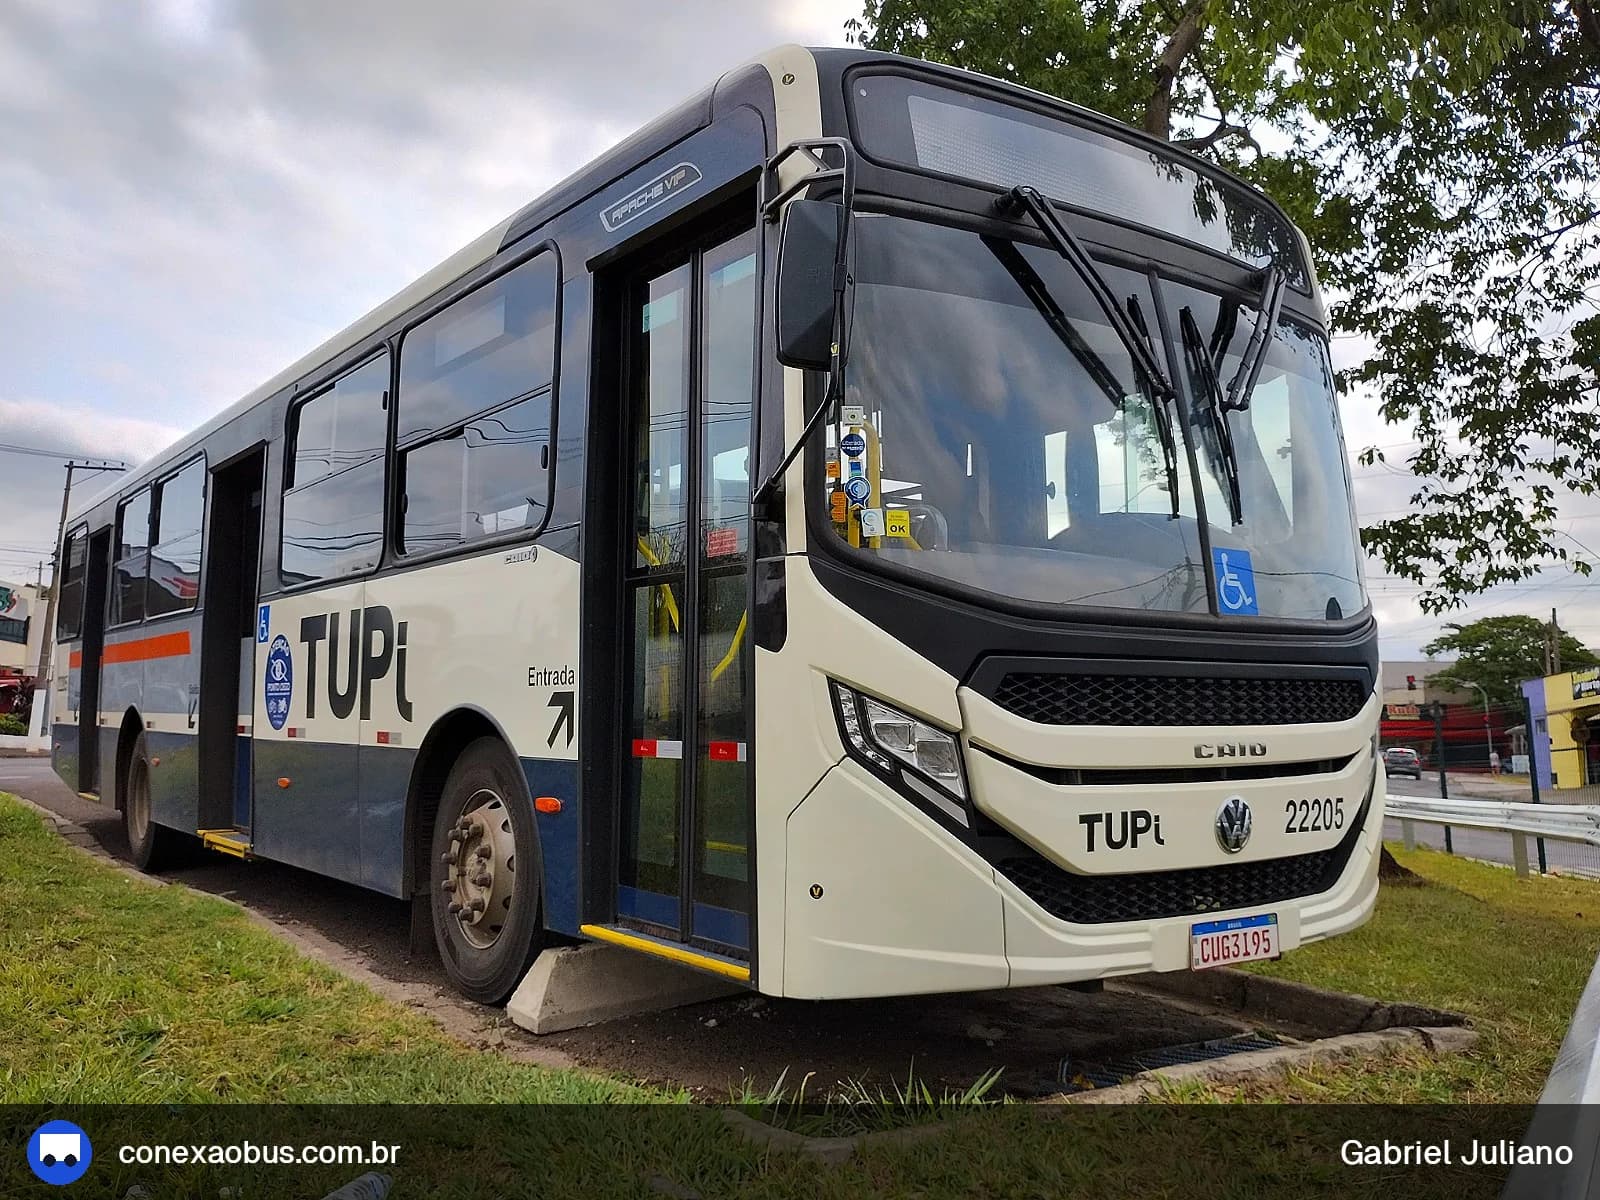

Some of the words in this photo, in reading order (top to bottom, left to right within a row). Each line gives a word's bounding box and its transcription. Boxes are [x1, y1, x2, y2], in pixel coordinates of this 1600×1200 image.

[612, 182, 664, 223] APACHE
[664, 169, 686, 190] VIP
[890, 525, 905, 533] OK
[528, 666, 575, 687] Entrada
[1194, 742, 1267, 759] CAIO
[1285, 797, 1344, 834] 22205
